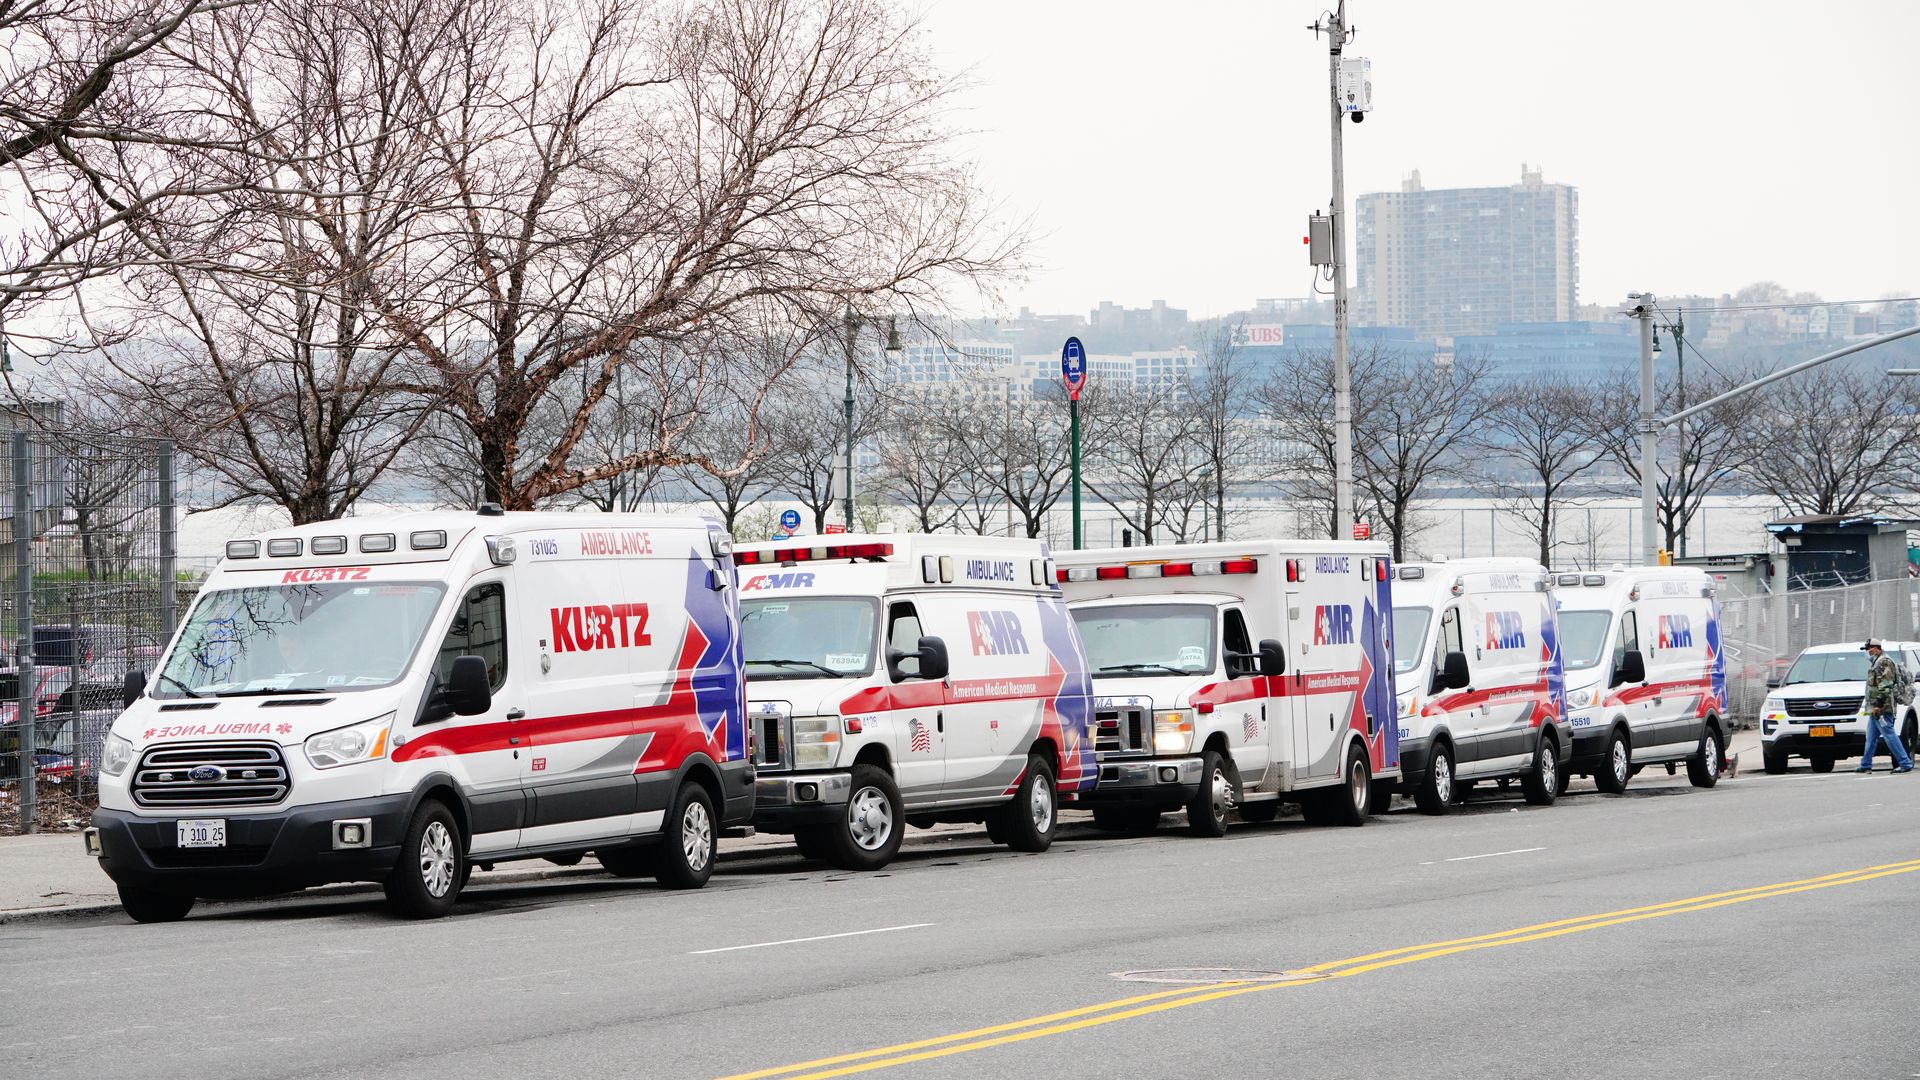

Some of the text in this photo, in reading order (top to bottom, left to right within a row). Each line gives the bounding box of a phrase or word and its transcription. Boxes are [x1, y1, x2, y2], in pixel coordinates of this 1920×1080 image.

[1250, 328, 1282, 342] UBS
[529, 539, 558, 556] 731025
[580, 532, 653, 556] AMBULANCE
[966, 559, 1015, 581] AMBULANCE
[1315, 556, 1350, 574] AMBULANCE
[281, 567, 371, 584] KURTZ
[741, 572, 816, 592] AMR
[1489, 573, 1521, 590] AMBULANCE
[550, 602, 652, 653] KURTZ
[966, 609, 1030, 656] AMR
[1313, 604, 1354, 646] AMR
[1485, 611, 1526, 650] AMR
[1658, 614, 1693, 649] AMR
[953, 682, 1036, 698] American Medical Response
[1308, 674, 1360, 689] American Medical Response
[1571, 717, 1590, 726] 15510
[194, 769, 214, 778] Ford
[179, 827, 224, 841] 7 310 25
